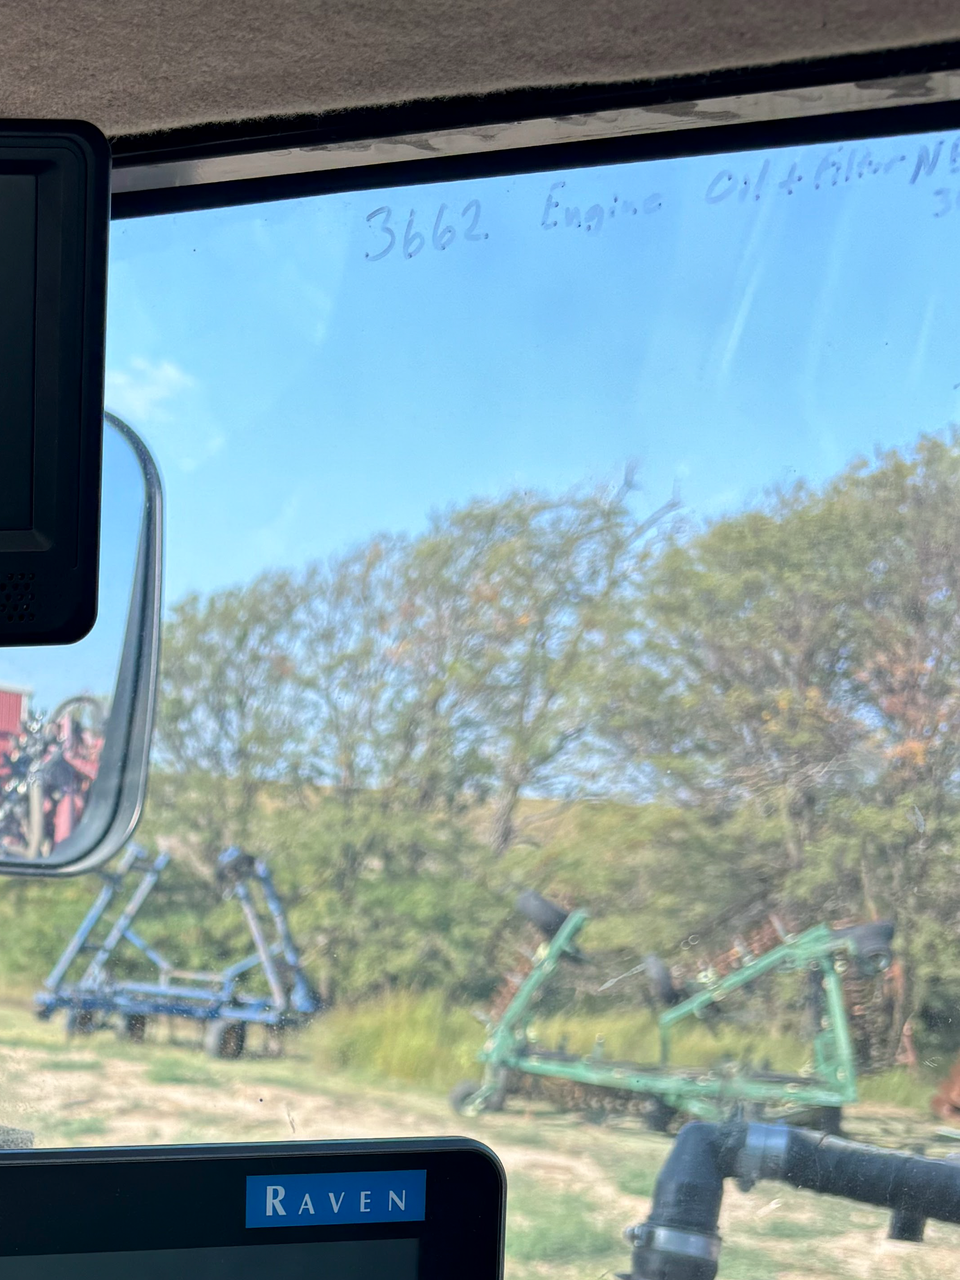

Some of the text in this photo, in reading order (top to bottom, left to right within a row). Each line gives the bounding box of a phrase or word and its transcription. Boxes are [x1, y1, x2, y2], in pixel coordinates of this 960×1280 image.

[541, 180, 663, 237] Engine
[704, 157, 771, 205] Oil
[265, 1184, 406, 1217] RAVEN
